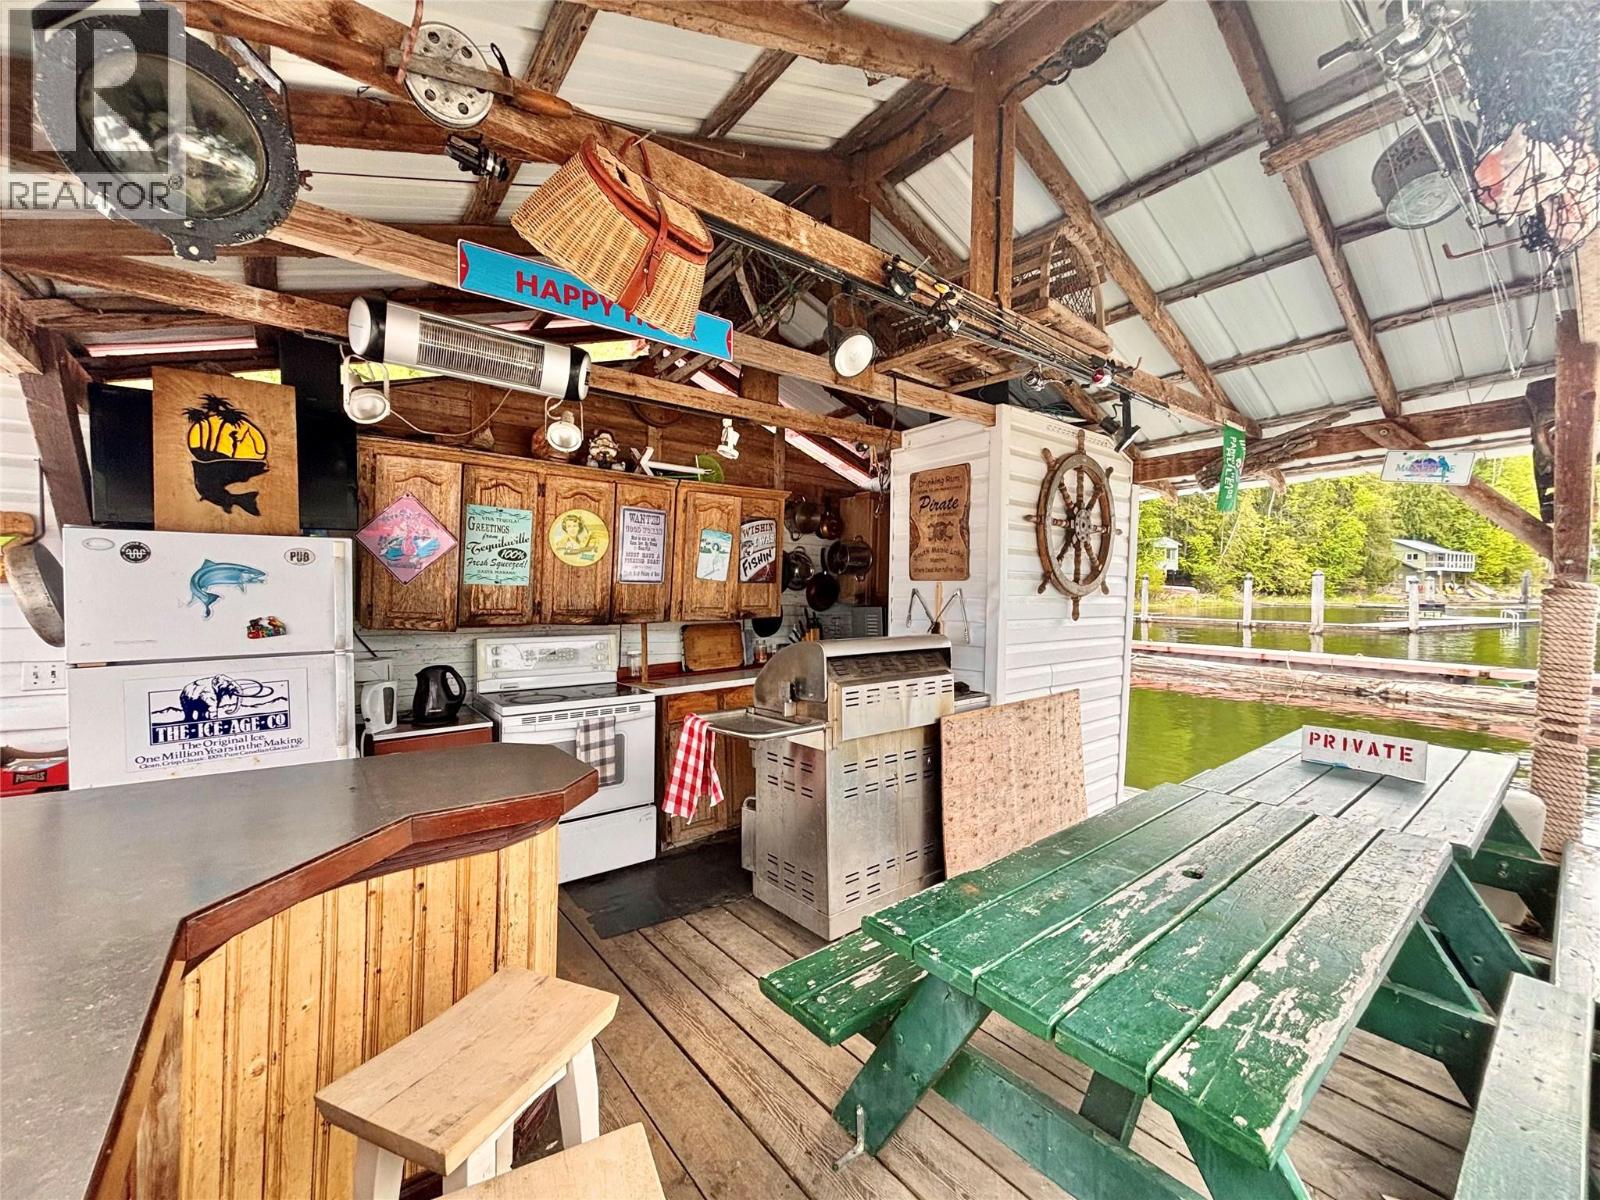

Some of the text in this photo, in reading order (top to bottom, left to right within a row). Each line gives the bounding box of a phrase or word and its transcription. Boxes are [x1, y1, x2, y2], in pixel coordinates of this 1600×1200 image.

[516, 271, 614, 316] HAPPY
[919, 495, 959, 513] Pirate
[468, 516, 510, 534] GREETINGS
[629, 513, 660, 525] WANTED
[466, 532, 530, 555] Tequilaville
[289, 551, 310, 563] PUB
[500, 549, 525, 559] 100%
[466, 557, 528, 570] Fresh Squeezed!
[178, 741, 202, 751] The
[202, 735, 248, 749] Original
[1309, 732, 1413, 762] PRIVATE
[135, 755, 160, 764] One
[162, 749, 204, 761] Million
[205, 745, 234, 757] Years
[234, 744, 244, 752] in
[244, 741, 263, 751] the
[223, 751, 239, 759] Pure
[239, 747, 268, 757] Canadian
